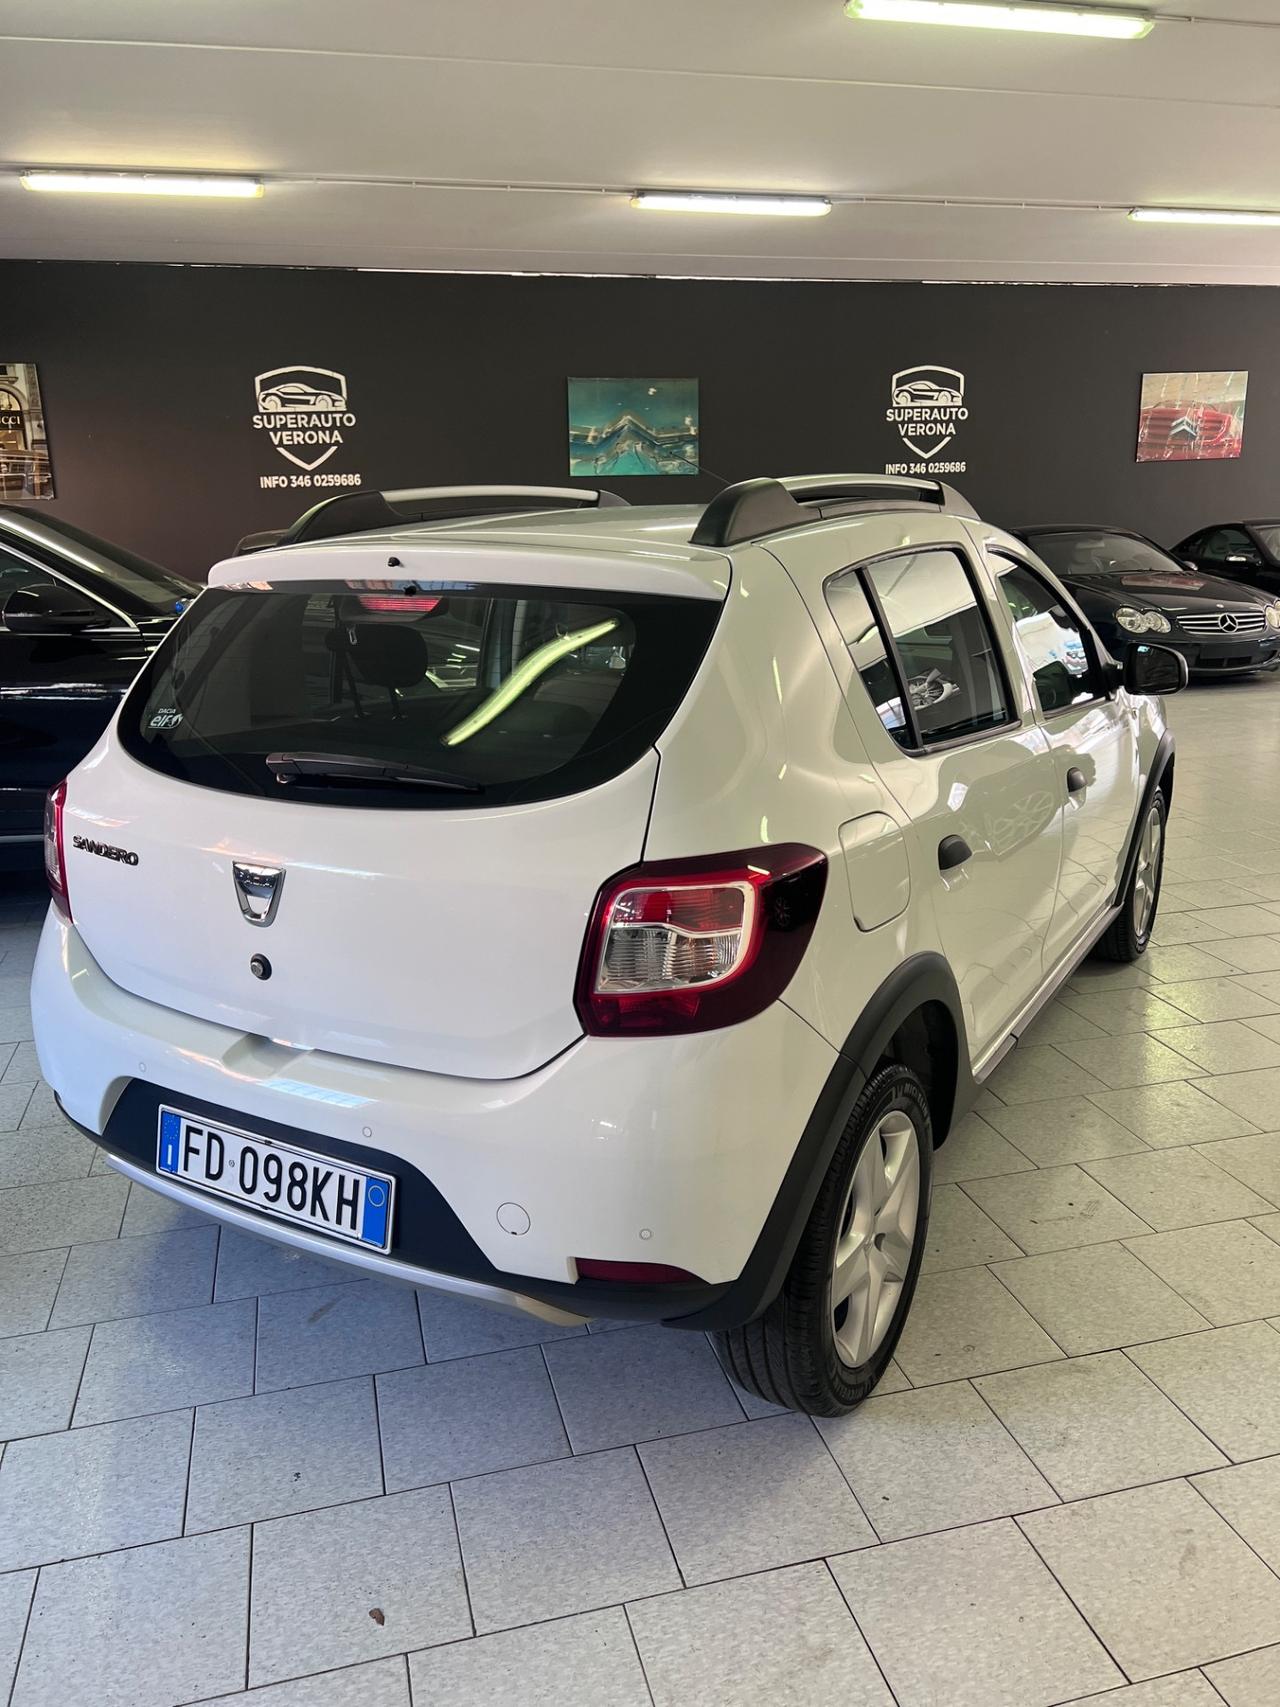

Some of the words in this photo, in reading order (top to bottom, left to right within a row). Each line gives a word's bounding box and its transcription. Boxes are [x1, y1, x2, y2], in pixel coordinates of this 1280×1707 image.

[0, 415, 21, 425] CCI
[252, 413, 356, 429] SUPERAUTO
[887, 407, 968, 421] SUPERAUTO
[898, 422, 957, 436] VERONA
[269, 430, 344, 445] VERONA
[885, 463, 908, 475] INFO
[909, 462, 927, 474] 346
[928, 461, 967, 473] 0259686
[260, 475, 288, 488] INFO
[290, 474, 312, 487] 346
[313, 473, 361, 487] 0259686
[73, 835, 139, 866] SANDERO
[183, 1124, 225, 1181] FD
[239, 1145, 360, 1231] 098KH
